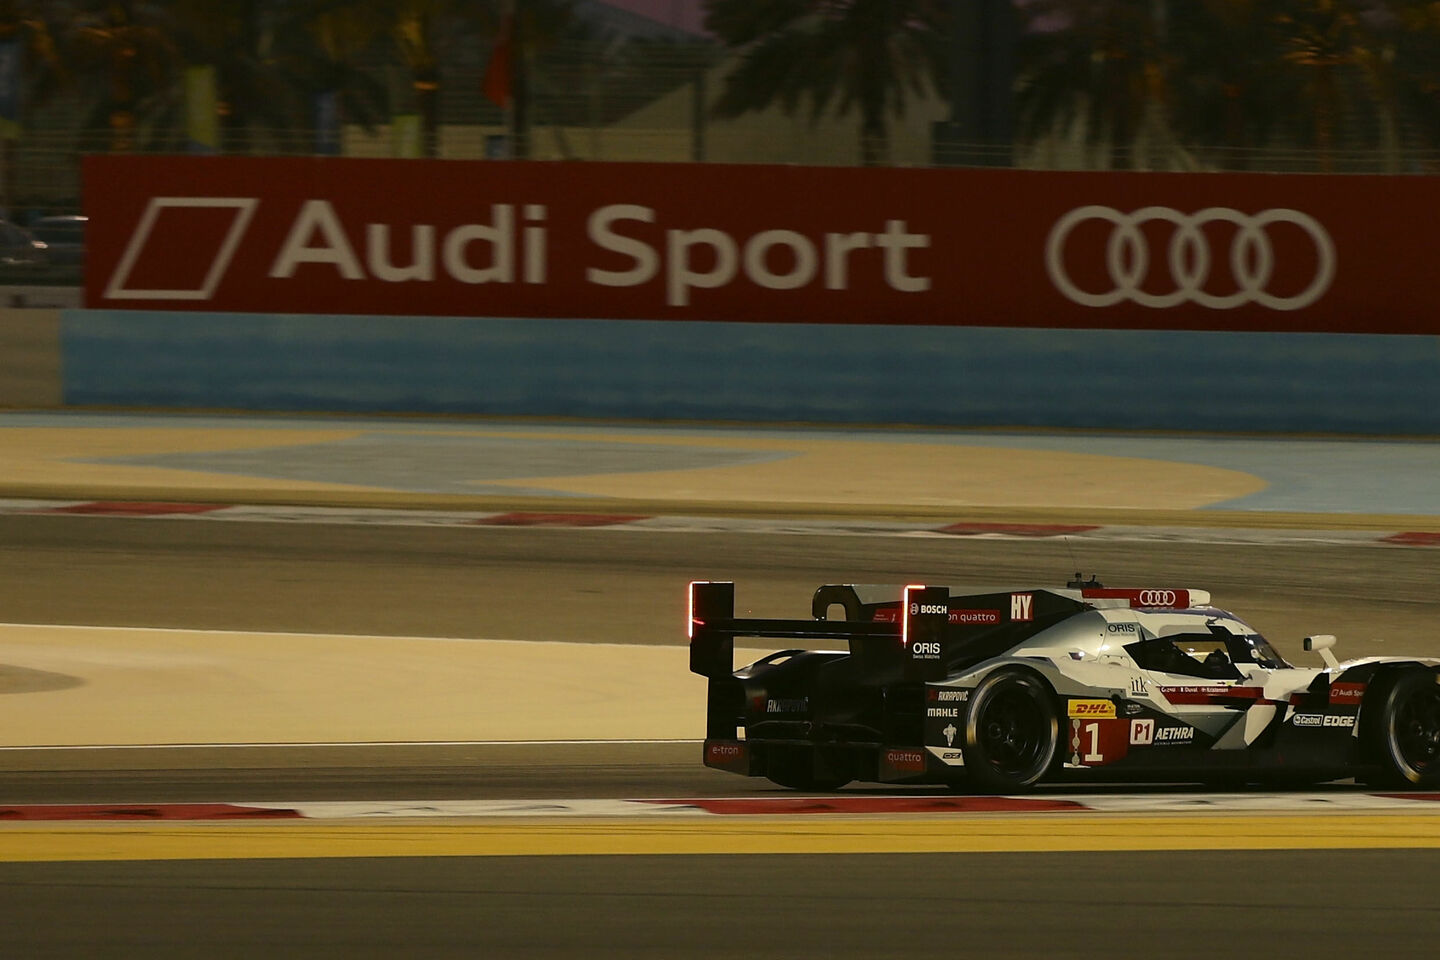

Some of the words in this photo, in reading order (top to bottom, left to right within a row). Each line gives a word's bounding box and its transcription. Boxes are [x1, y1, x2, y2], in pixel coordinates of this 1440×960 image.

[269, 198, 549, 284] Audi
[584, 203, 933, 306] Sport
[920, 605, 947, 614] BOSCH
[1011, 595, 1032, 620] HY
[960, 613, 996, 622] quattro
[1108, 623, 1135, 633] ORIS
[912, 642, 941, 654] ORIS
[927, 708, 958, 718] MAHLE
[1075, 704, 1110, 714] DHL
[1323, 715, 1355, 727] EDGE
[1134, 723, 1151, 741] P1
[1154, 726, 1194, 741] AETHRA
[1084, 722, 1104, 762] 1
[712, 746, 739, 755] e-tron
[887, 752, 922, 762] quattro
